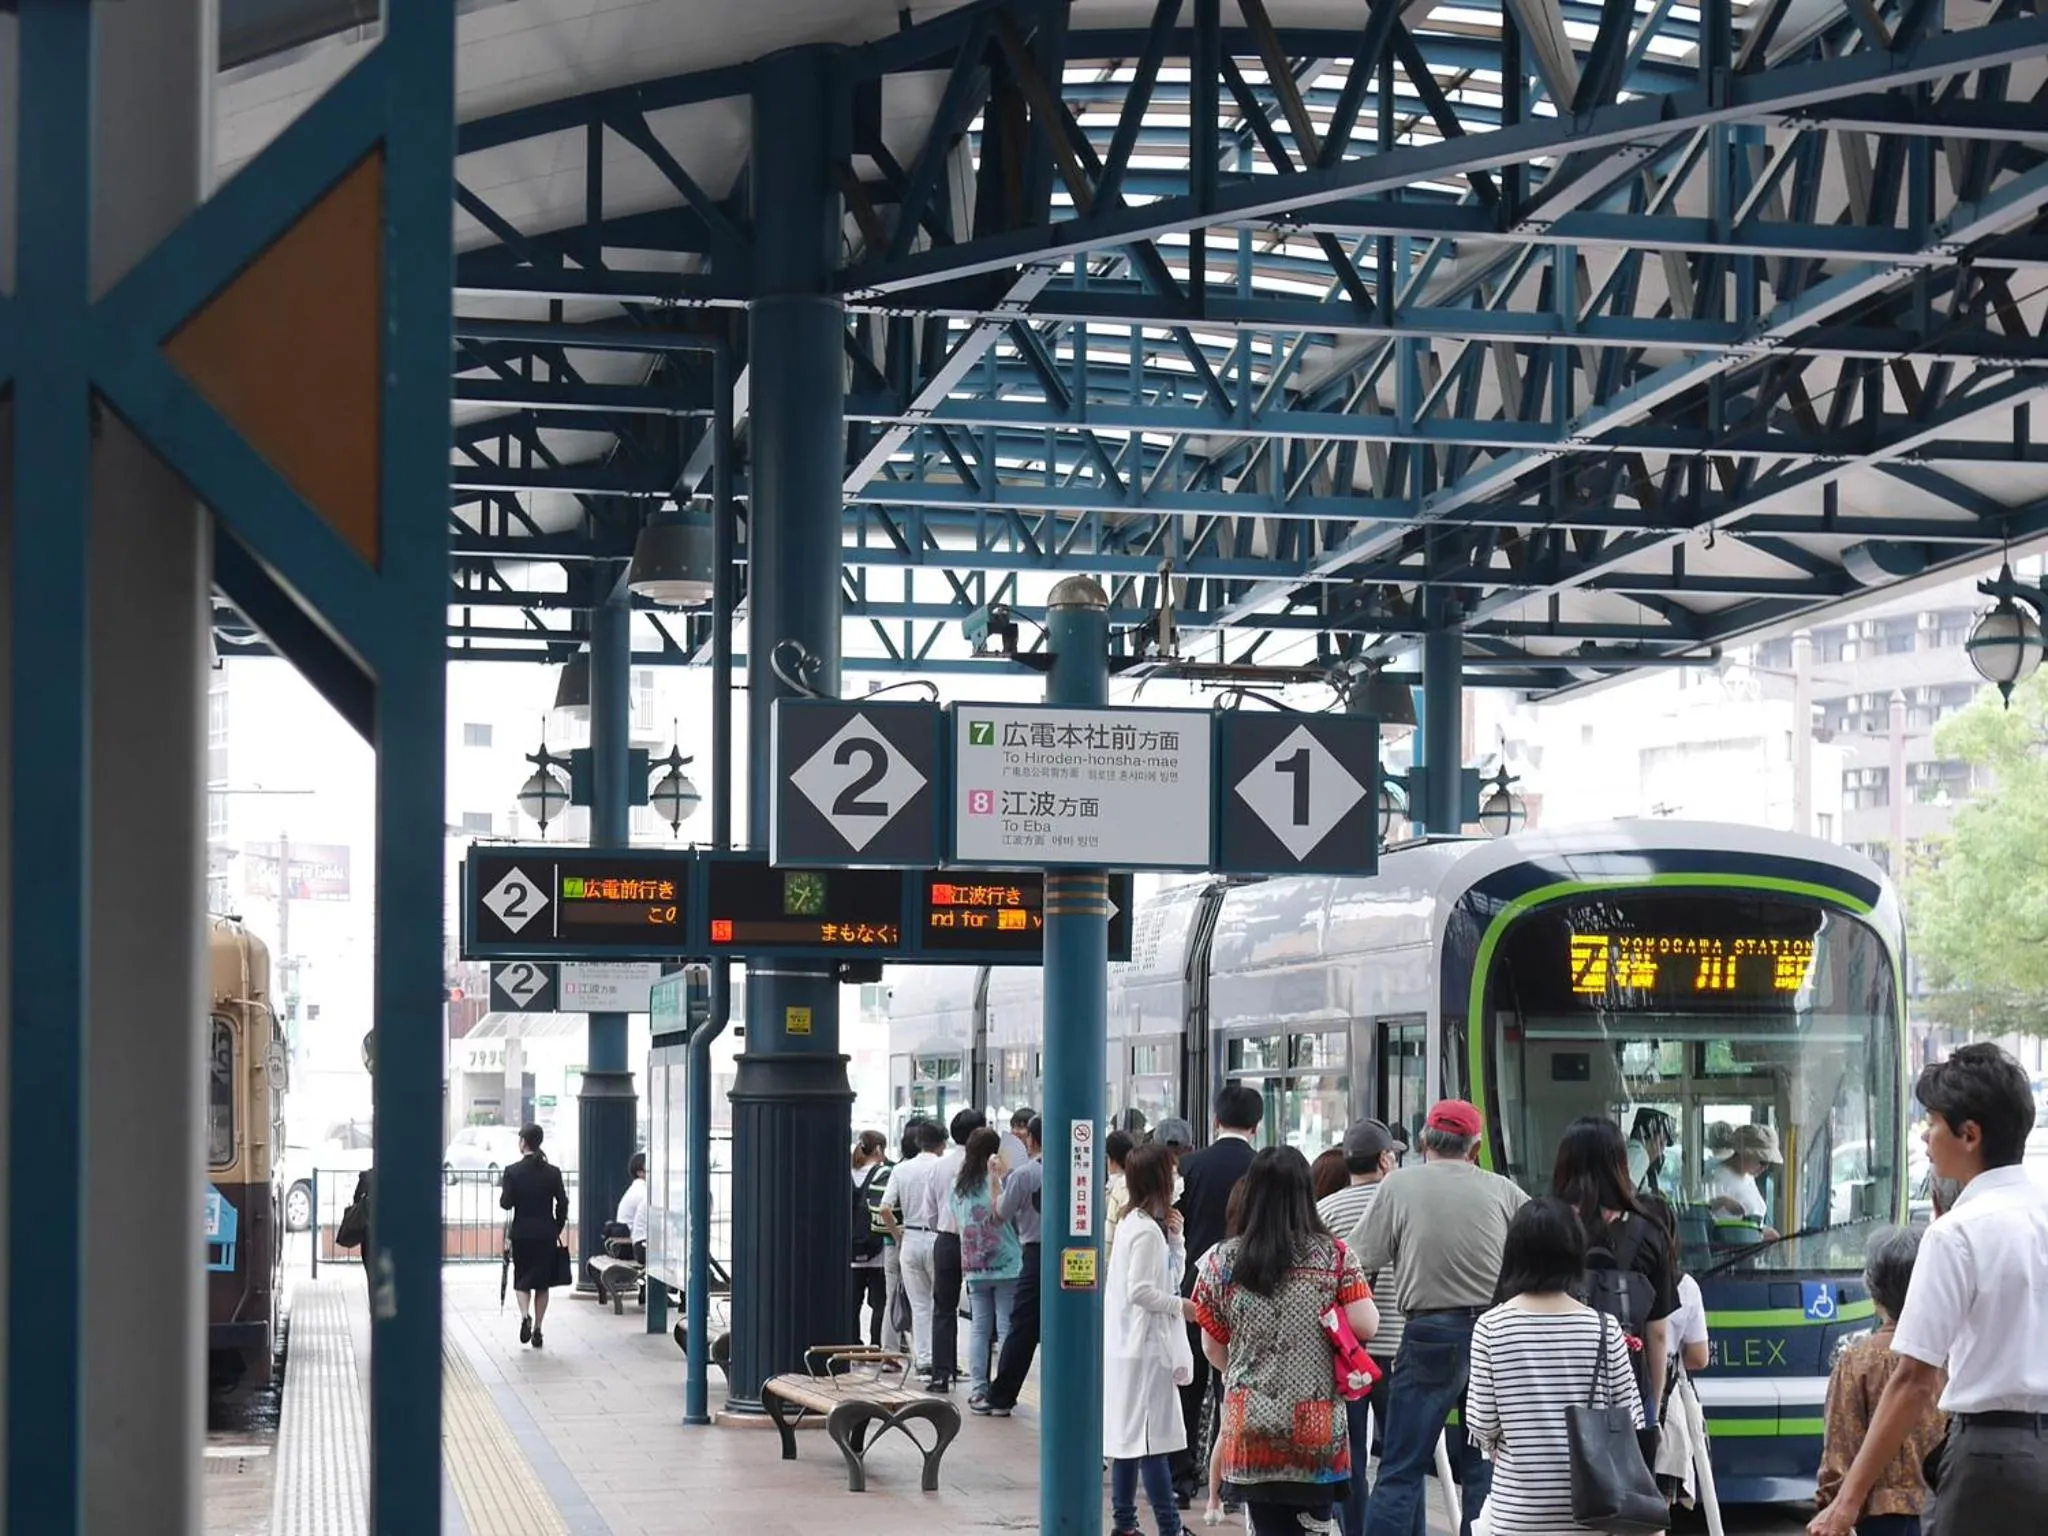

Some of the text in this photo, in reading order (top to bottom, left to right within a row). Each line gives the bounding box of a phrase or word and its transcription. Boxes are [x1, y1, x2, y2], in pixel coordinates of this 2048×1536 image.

[973, 721, 1179, 750] 7 広電本社前方面
[1003, 751, 1178, 768] To Hiroden-honsha-mae
[832, 737, 888, 816] 2
[1275, 748, 1310, 826] 1
[974, 790, 1099, 817] 8 江波方面
[1003, 819, 1051, 832] To Eba
[503, 882, 528, 918] 2
[584, 879, 675, 900] 広電前行き
[952, 886, 1021, 905] 江波行き
[961, 911, 989, 927] for
[822, 923, 897, 943] まもなく
[1620, 937, 1814, 955] YOKOGAWA STATION
[511, 963, 534, 994] 2
[1723, 1338, 1787, 1367] LEX
